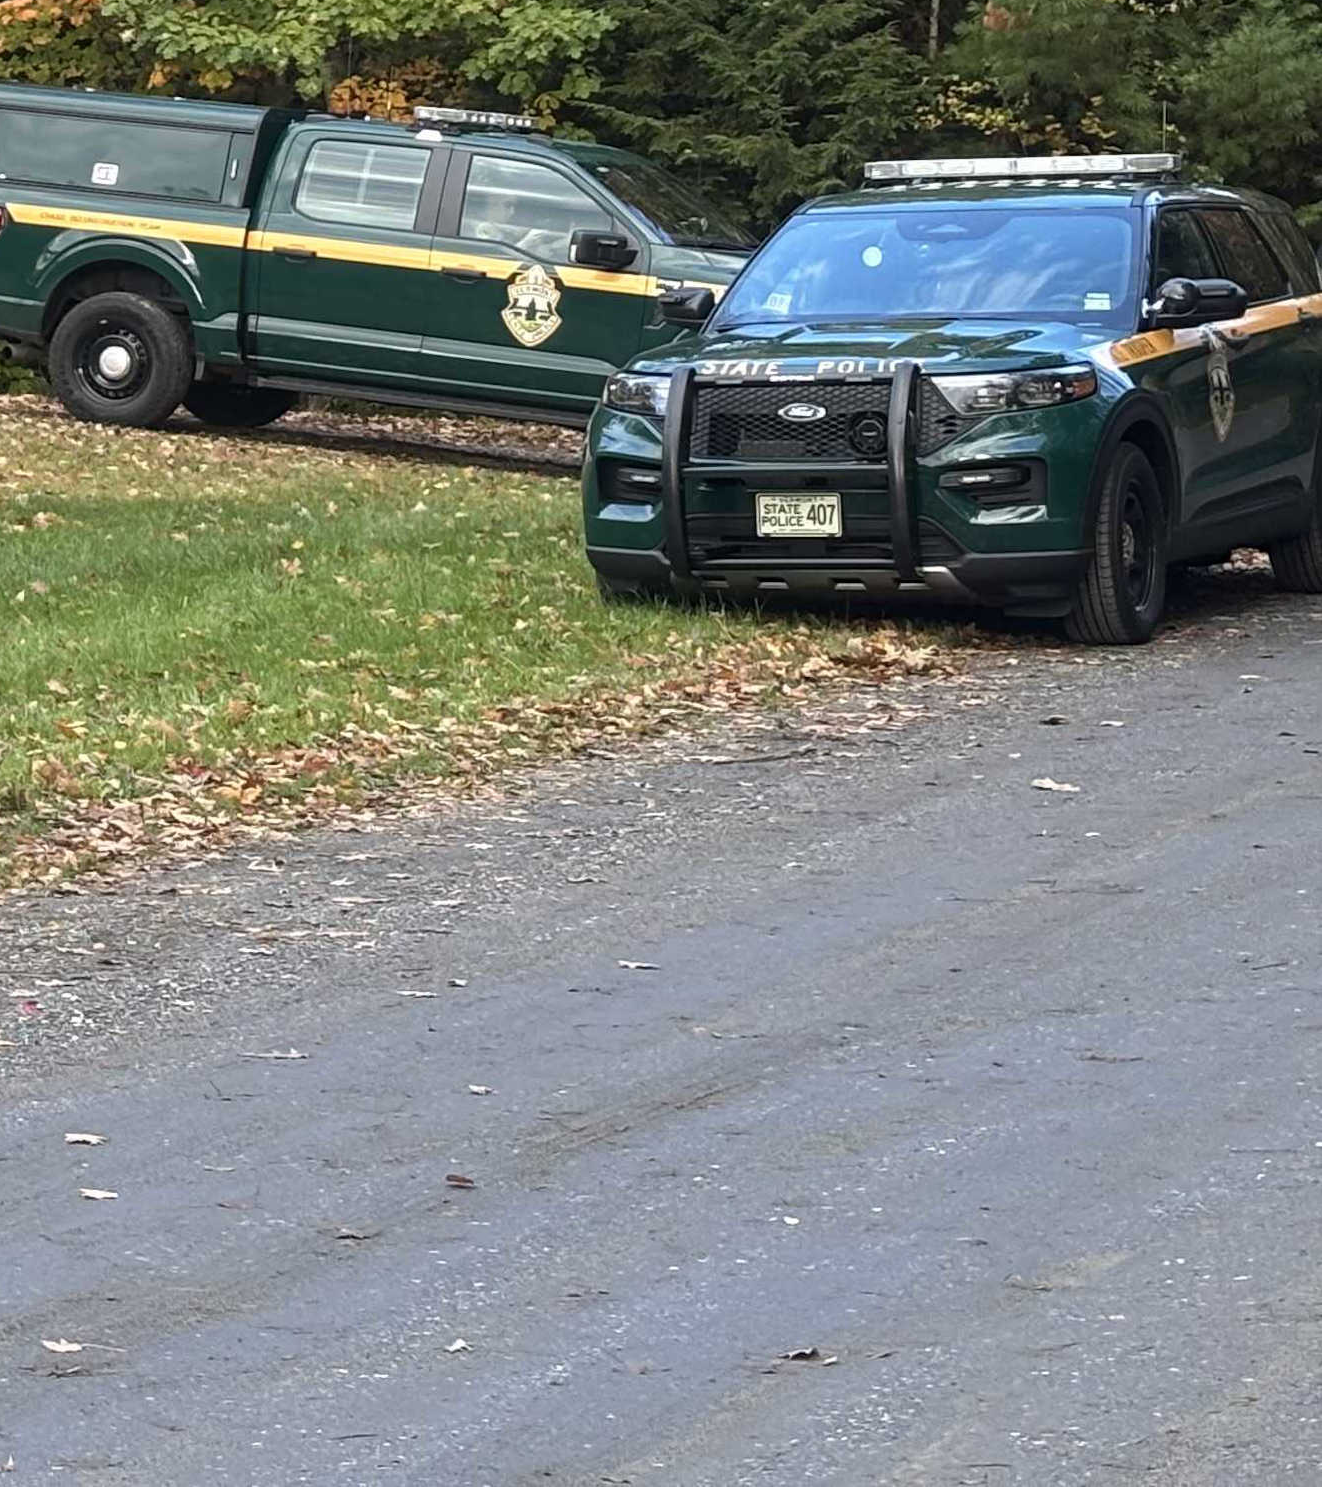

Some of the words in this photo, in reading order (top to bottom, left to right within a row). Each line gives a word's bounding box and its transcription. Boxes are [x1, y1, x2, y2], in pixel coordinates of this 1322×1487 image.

[701, 360, 784, 375] STATE
[762, 515, 804, 526] POLICE
[764, 503, 801, 514] STATE
[807, 504, 836, 525] 407
